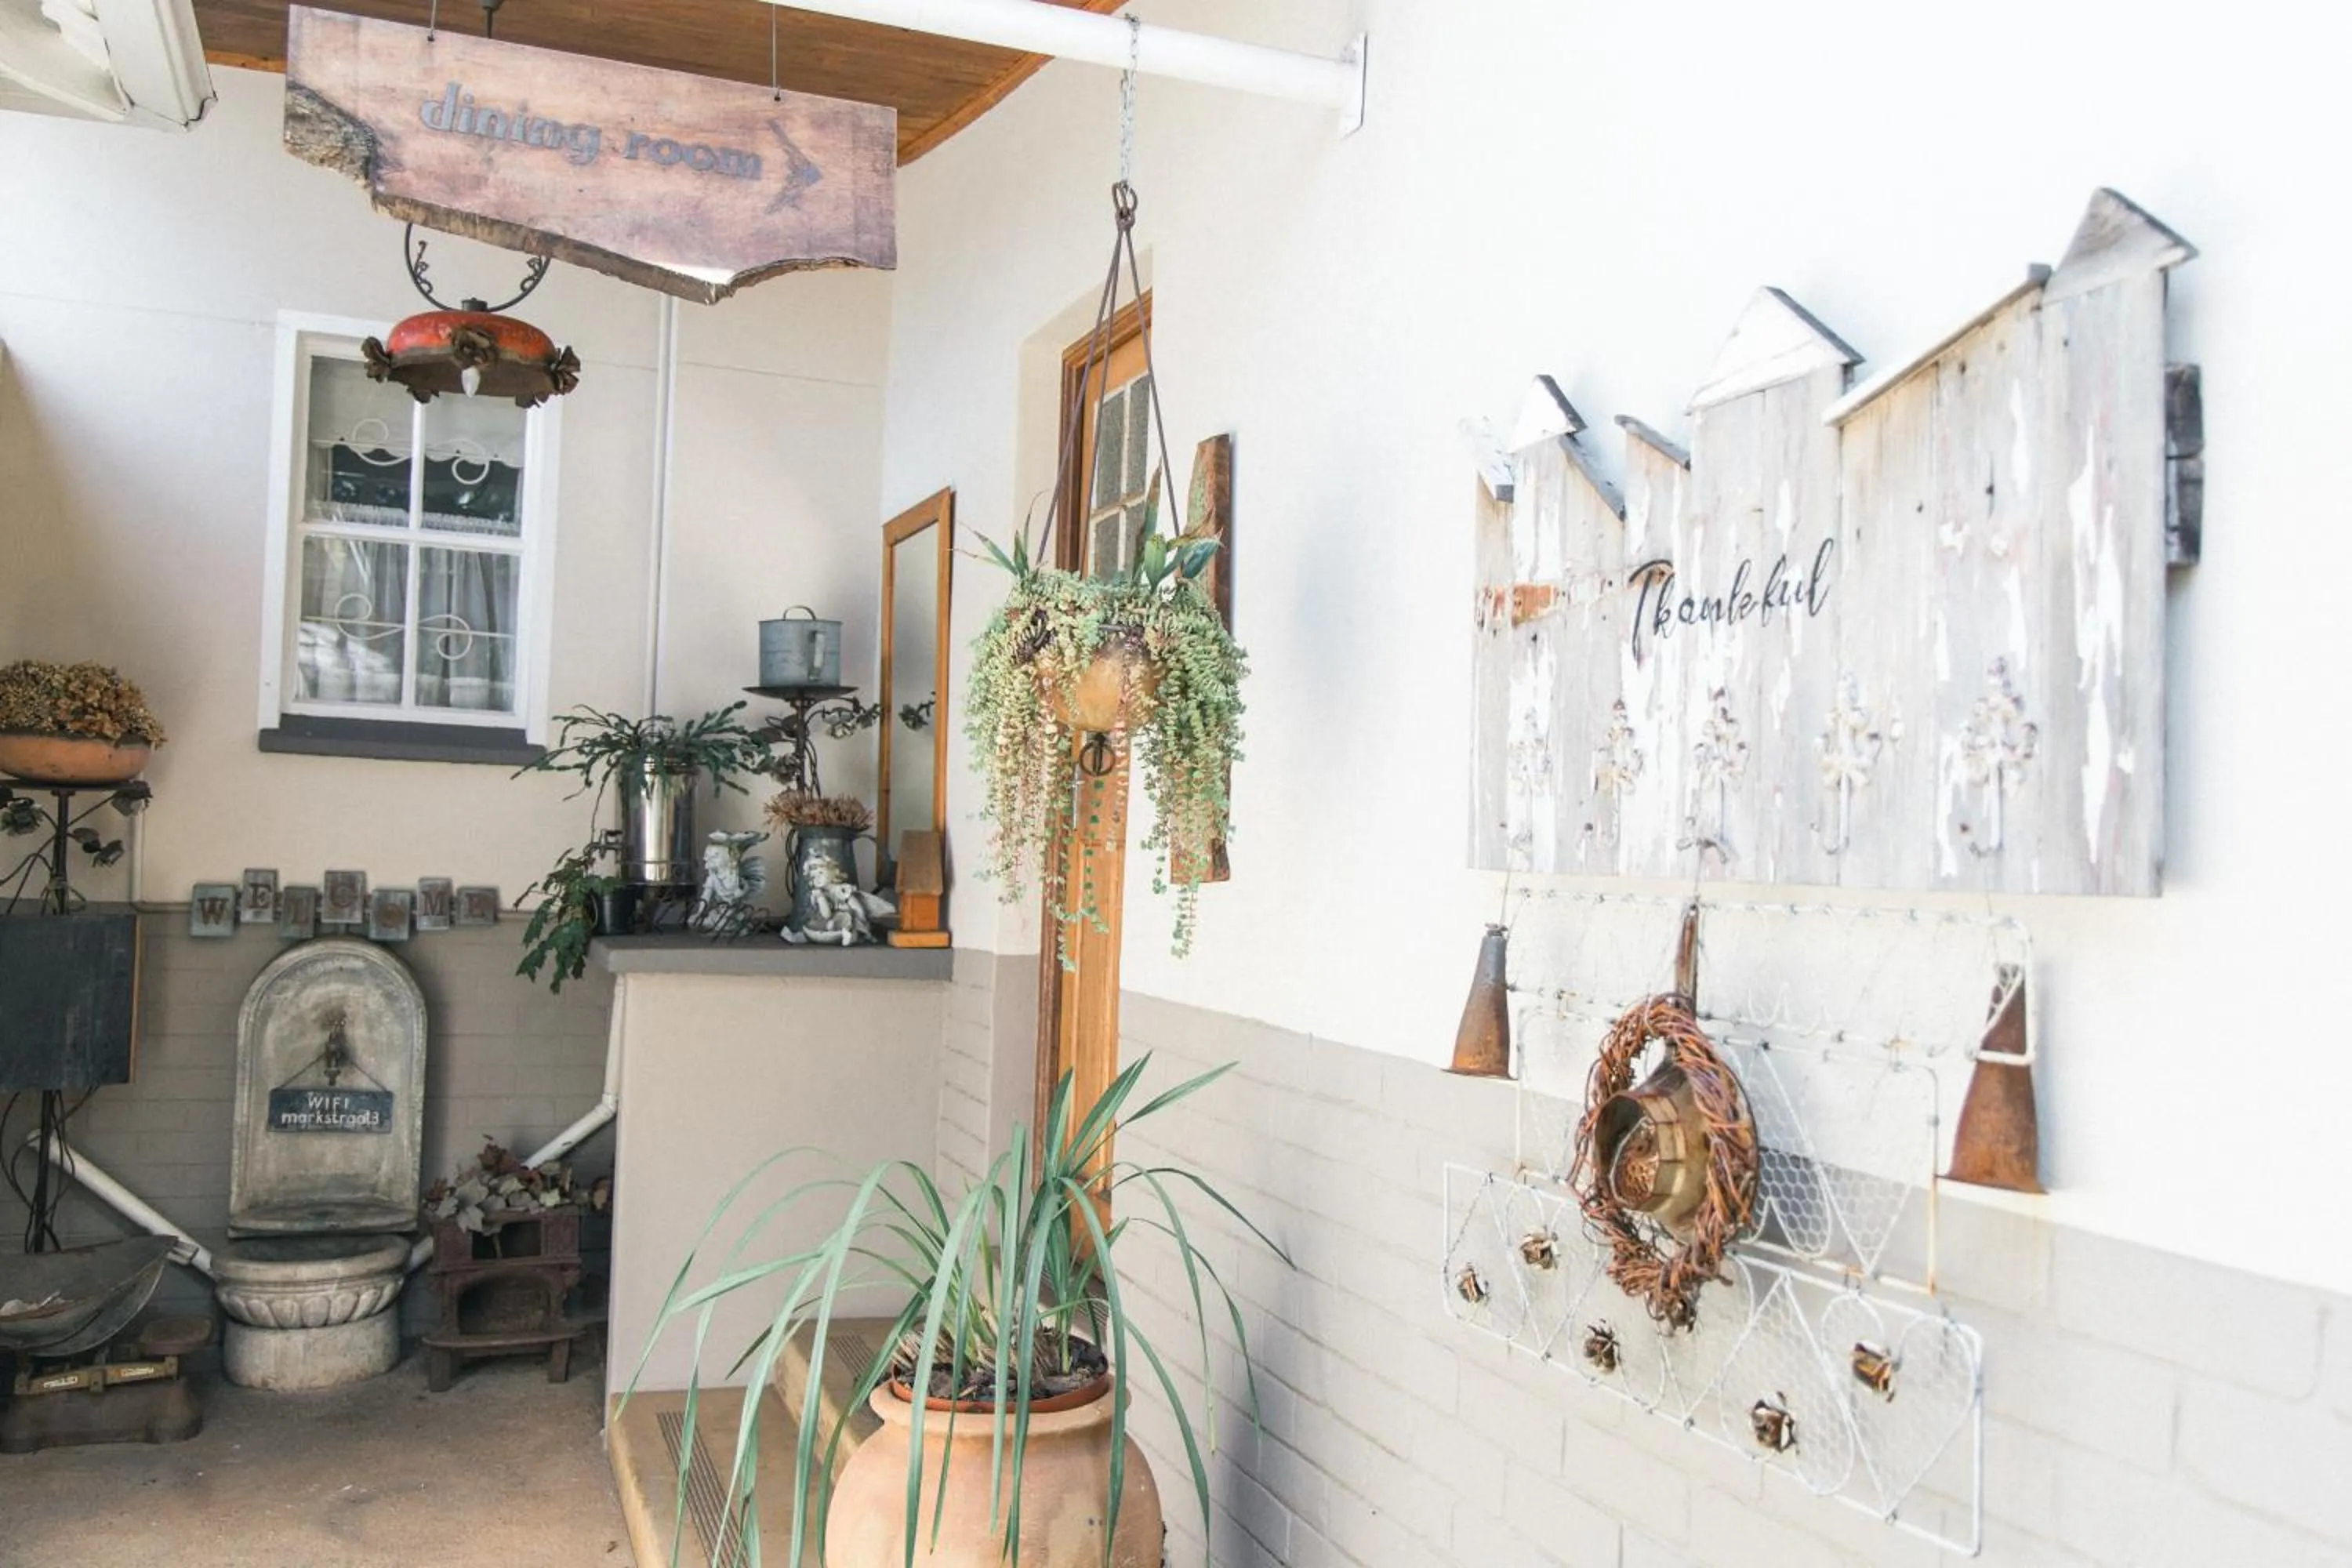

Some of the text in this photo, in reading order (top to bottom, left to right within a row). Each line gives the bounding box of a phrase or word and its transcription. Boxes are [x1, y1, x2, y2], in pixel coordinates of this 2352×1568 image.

[419, 82, 764, 181] dining room
[1628, 538, 1835, 668] Thankful
[197, 882, 492, 927] WELCOME
[307, 1094, 350, 1111] WIFI
